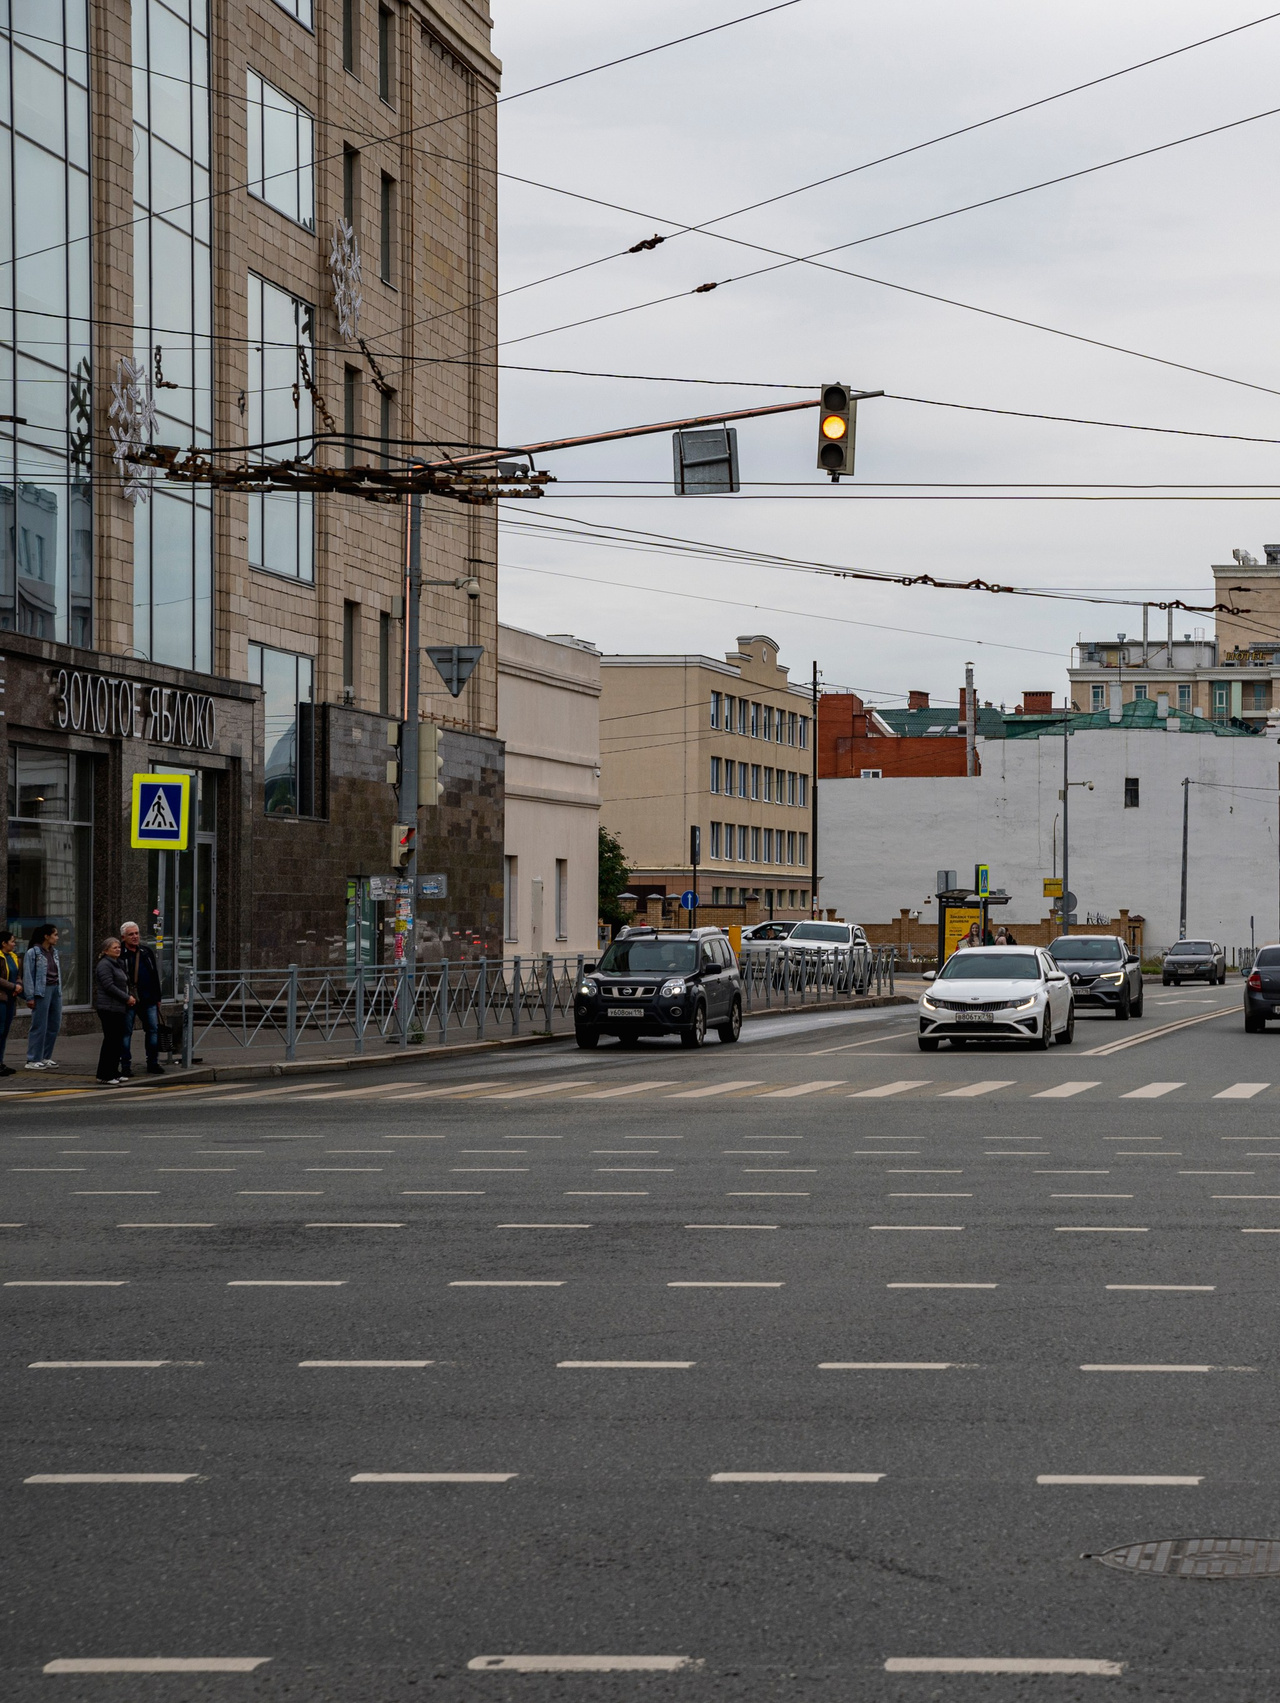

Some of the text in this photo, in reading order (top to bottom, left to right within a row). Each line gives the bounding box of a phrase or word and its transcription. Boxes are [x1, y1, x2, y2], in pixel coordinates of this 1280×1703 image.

[1225, 651, 1266, 661] HOTEL
[58, 669, 142, 738] ЗОЛОТОЕ
[149, 687, 216, 750] ЯБЛОКО
